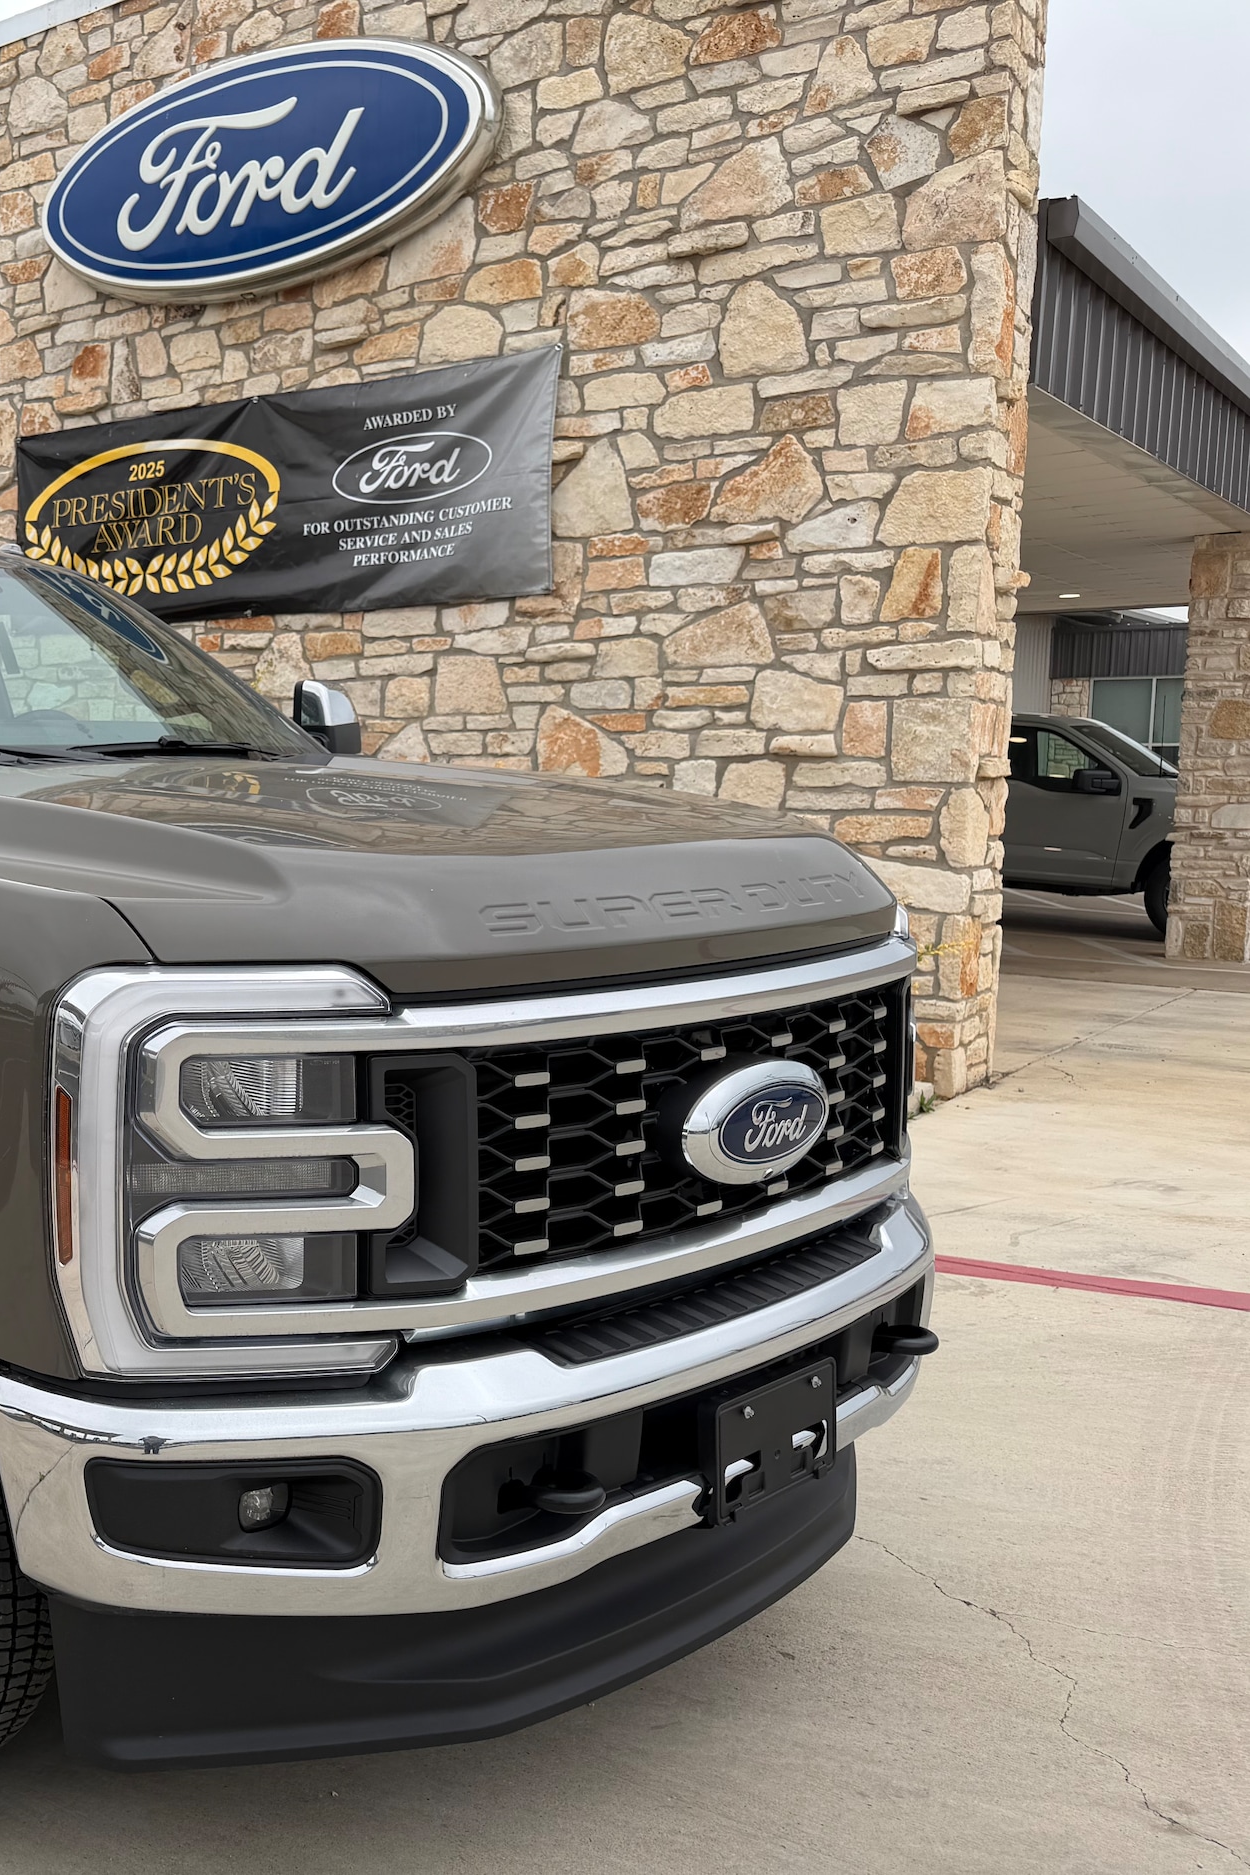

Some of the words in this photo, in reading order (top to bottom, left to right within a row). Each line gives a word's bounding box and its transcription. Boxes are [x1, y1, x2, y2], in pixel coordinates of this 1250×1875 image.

[116, 96, 365, 252] Ford
[363, 408, 433, 430] AWARDED
[437, 403, 457, 419] BY
[129, 460, 165, 481] 2025
[359, 441, 461, 494] Ford
[51, 473, 256, 529] PRESIDENT'S
[303, 521, 330, 536] FOR
[333, 510, 434, 533] OUTSTANDING
[439, 497, 513, 522] CUSTOMER
[91, 513, 203, 554] AWARD
[338, 532, 398, 551] SERVICE
[400, 529, 432, 544] AND
[433, 521, 473, 541] SALES
[353, 543, 455, 567] PERFORMANCE
[479, 887, 743, 937] SUPER
[740, 872, 865, 912] DUTY
[744, 1097, 808, 1152] Ford
